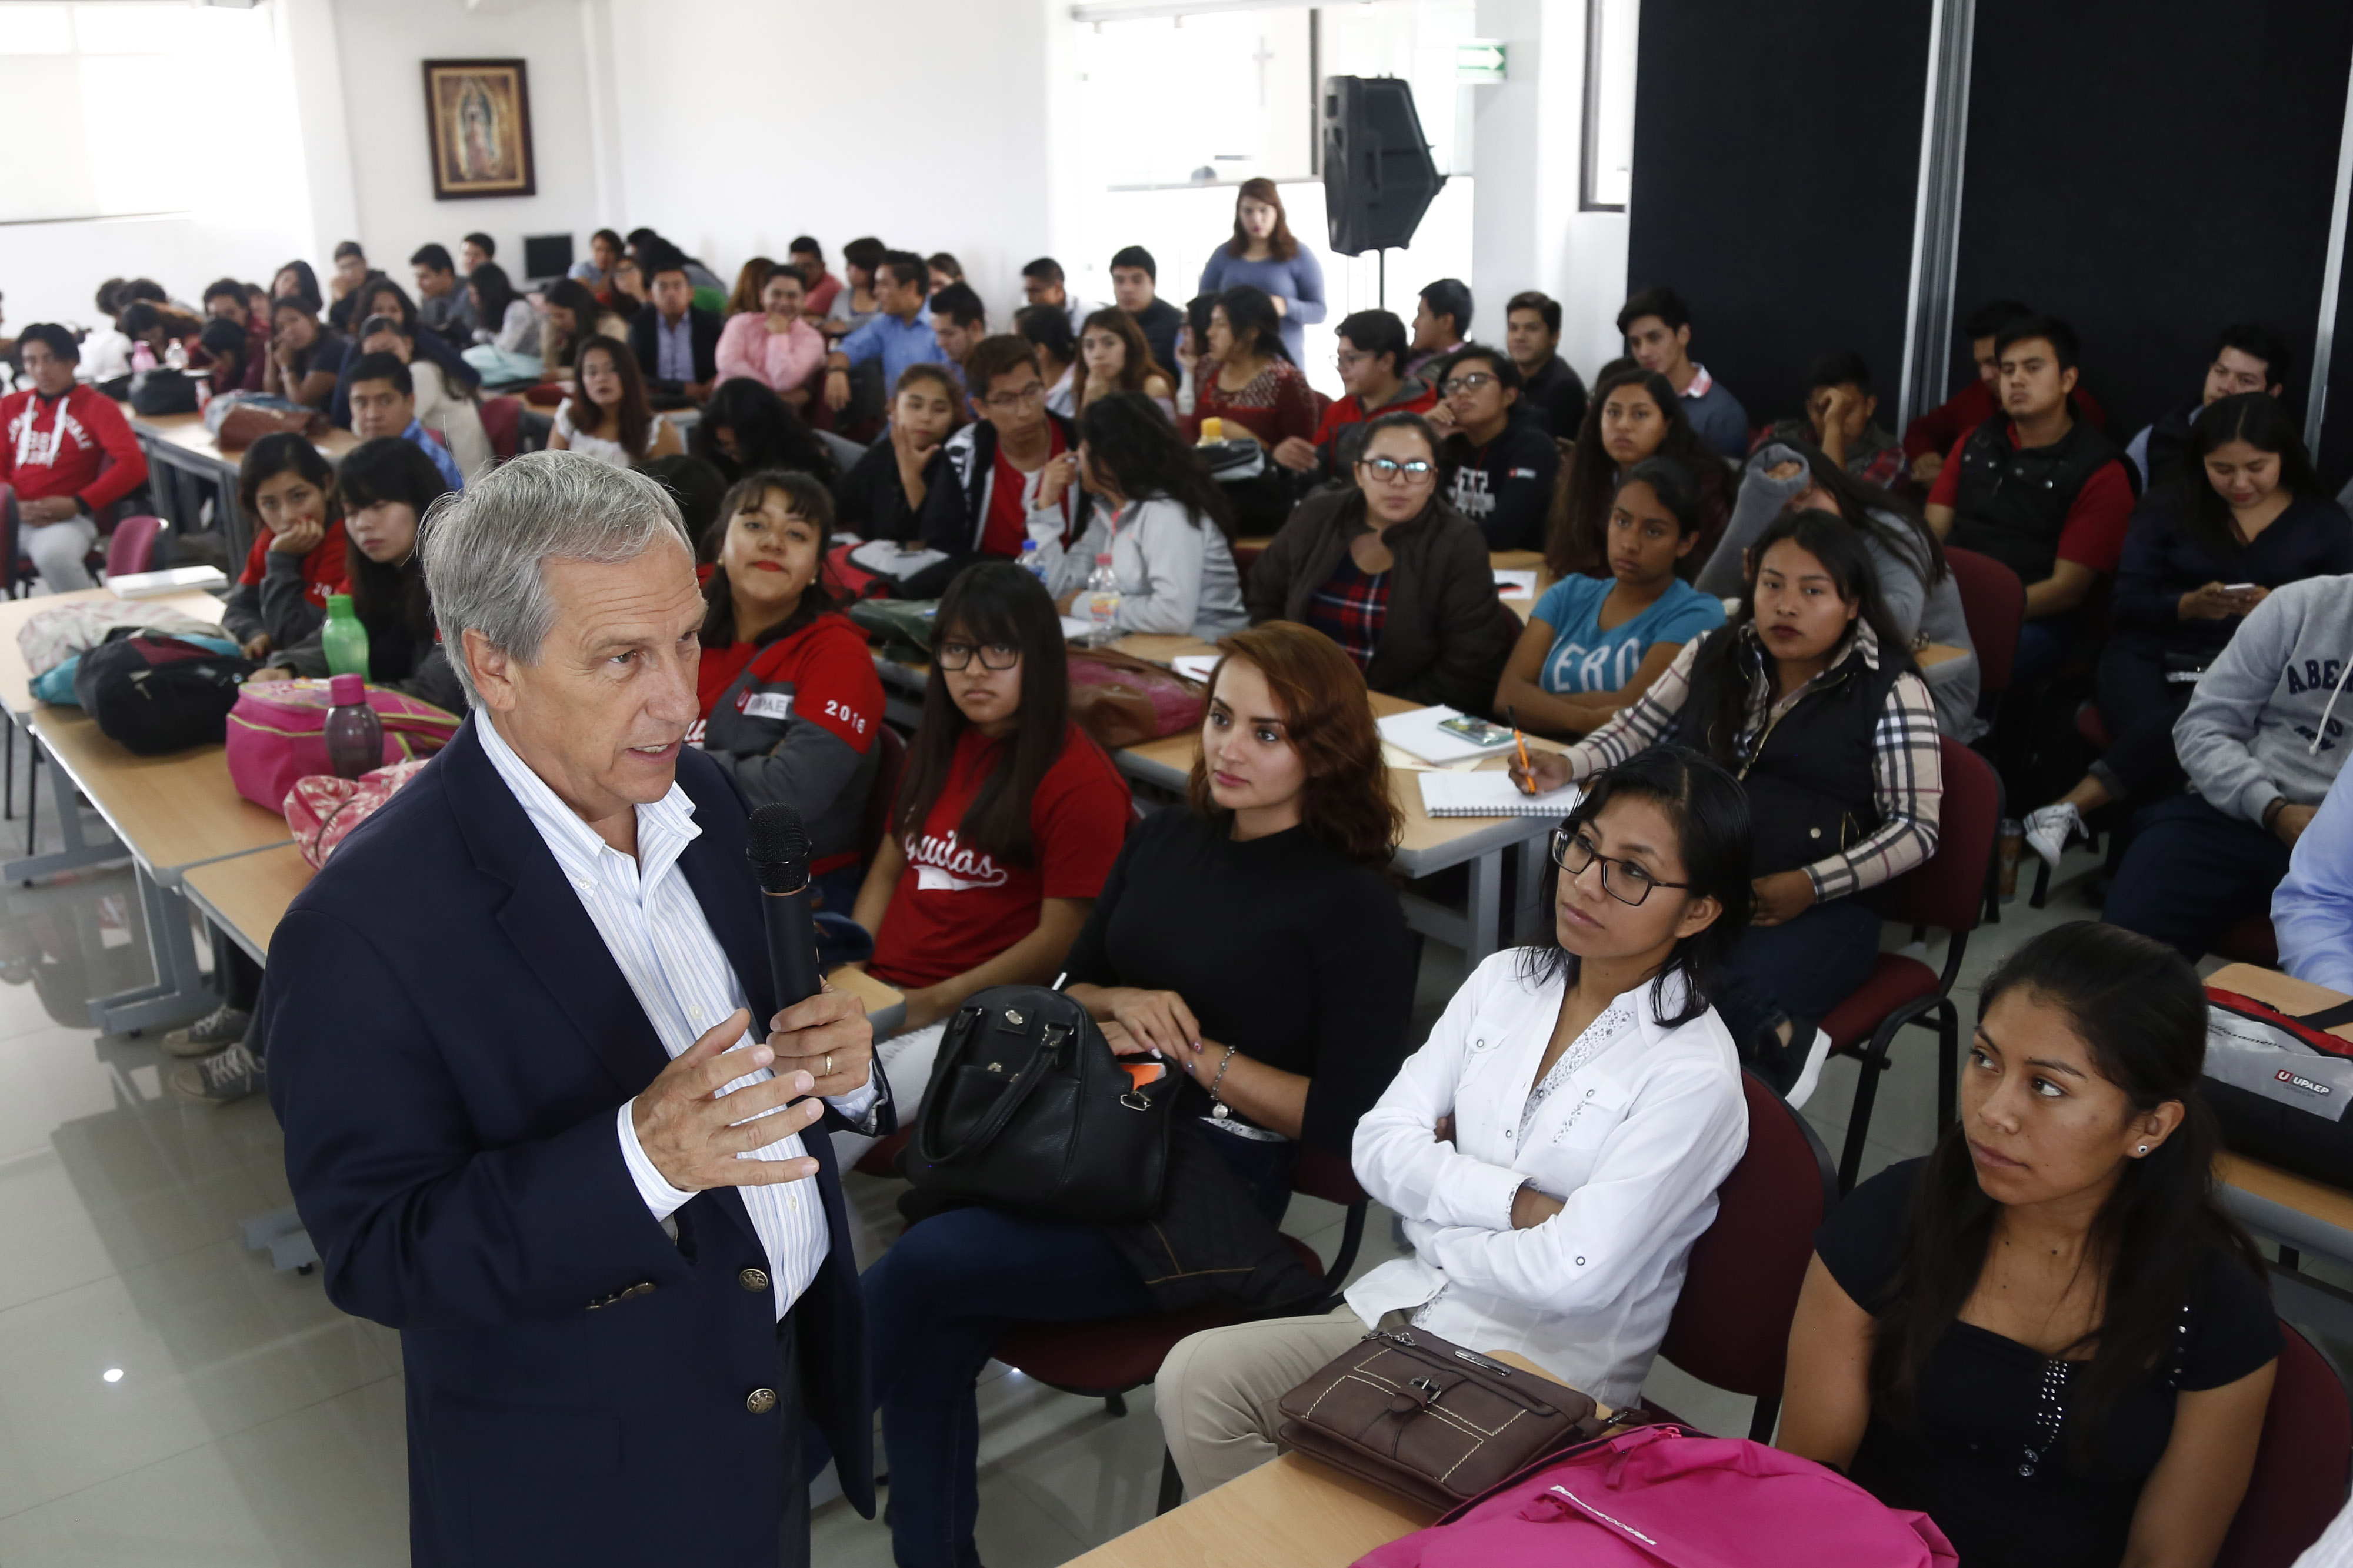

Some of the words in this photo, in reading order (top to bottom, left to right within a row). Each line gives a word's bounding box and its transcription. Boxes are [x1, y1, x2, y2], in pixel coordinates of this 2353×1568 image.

[1540, 636, 1641, 692] ERO
[824, 699, 866, 734] 2016
[2278, 1071, 2291, 1080] U
[2293, 1077, 2329, 1094] UPAEP
